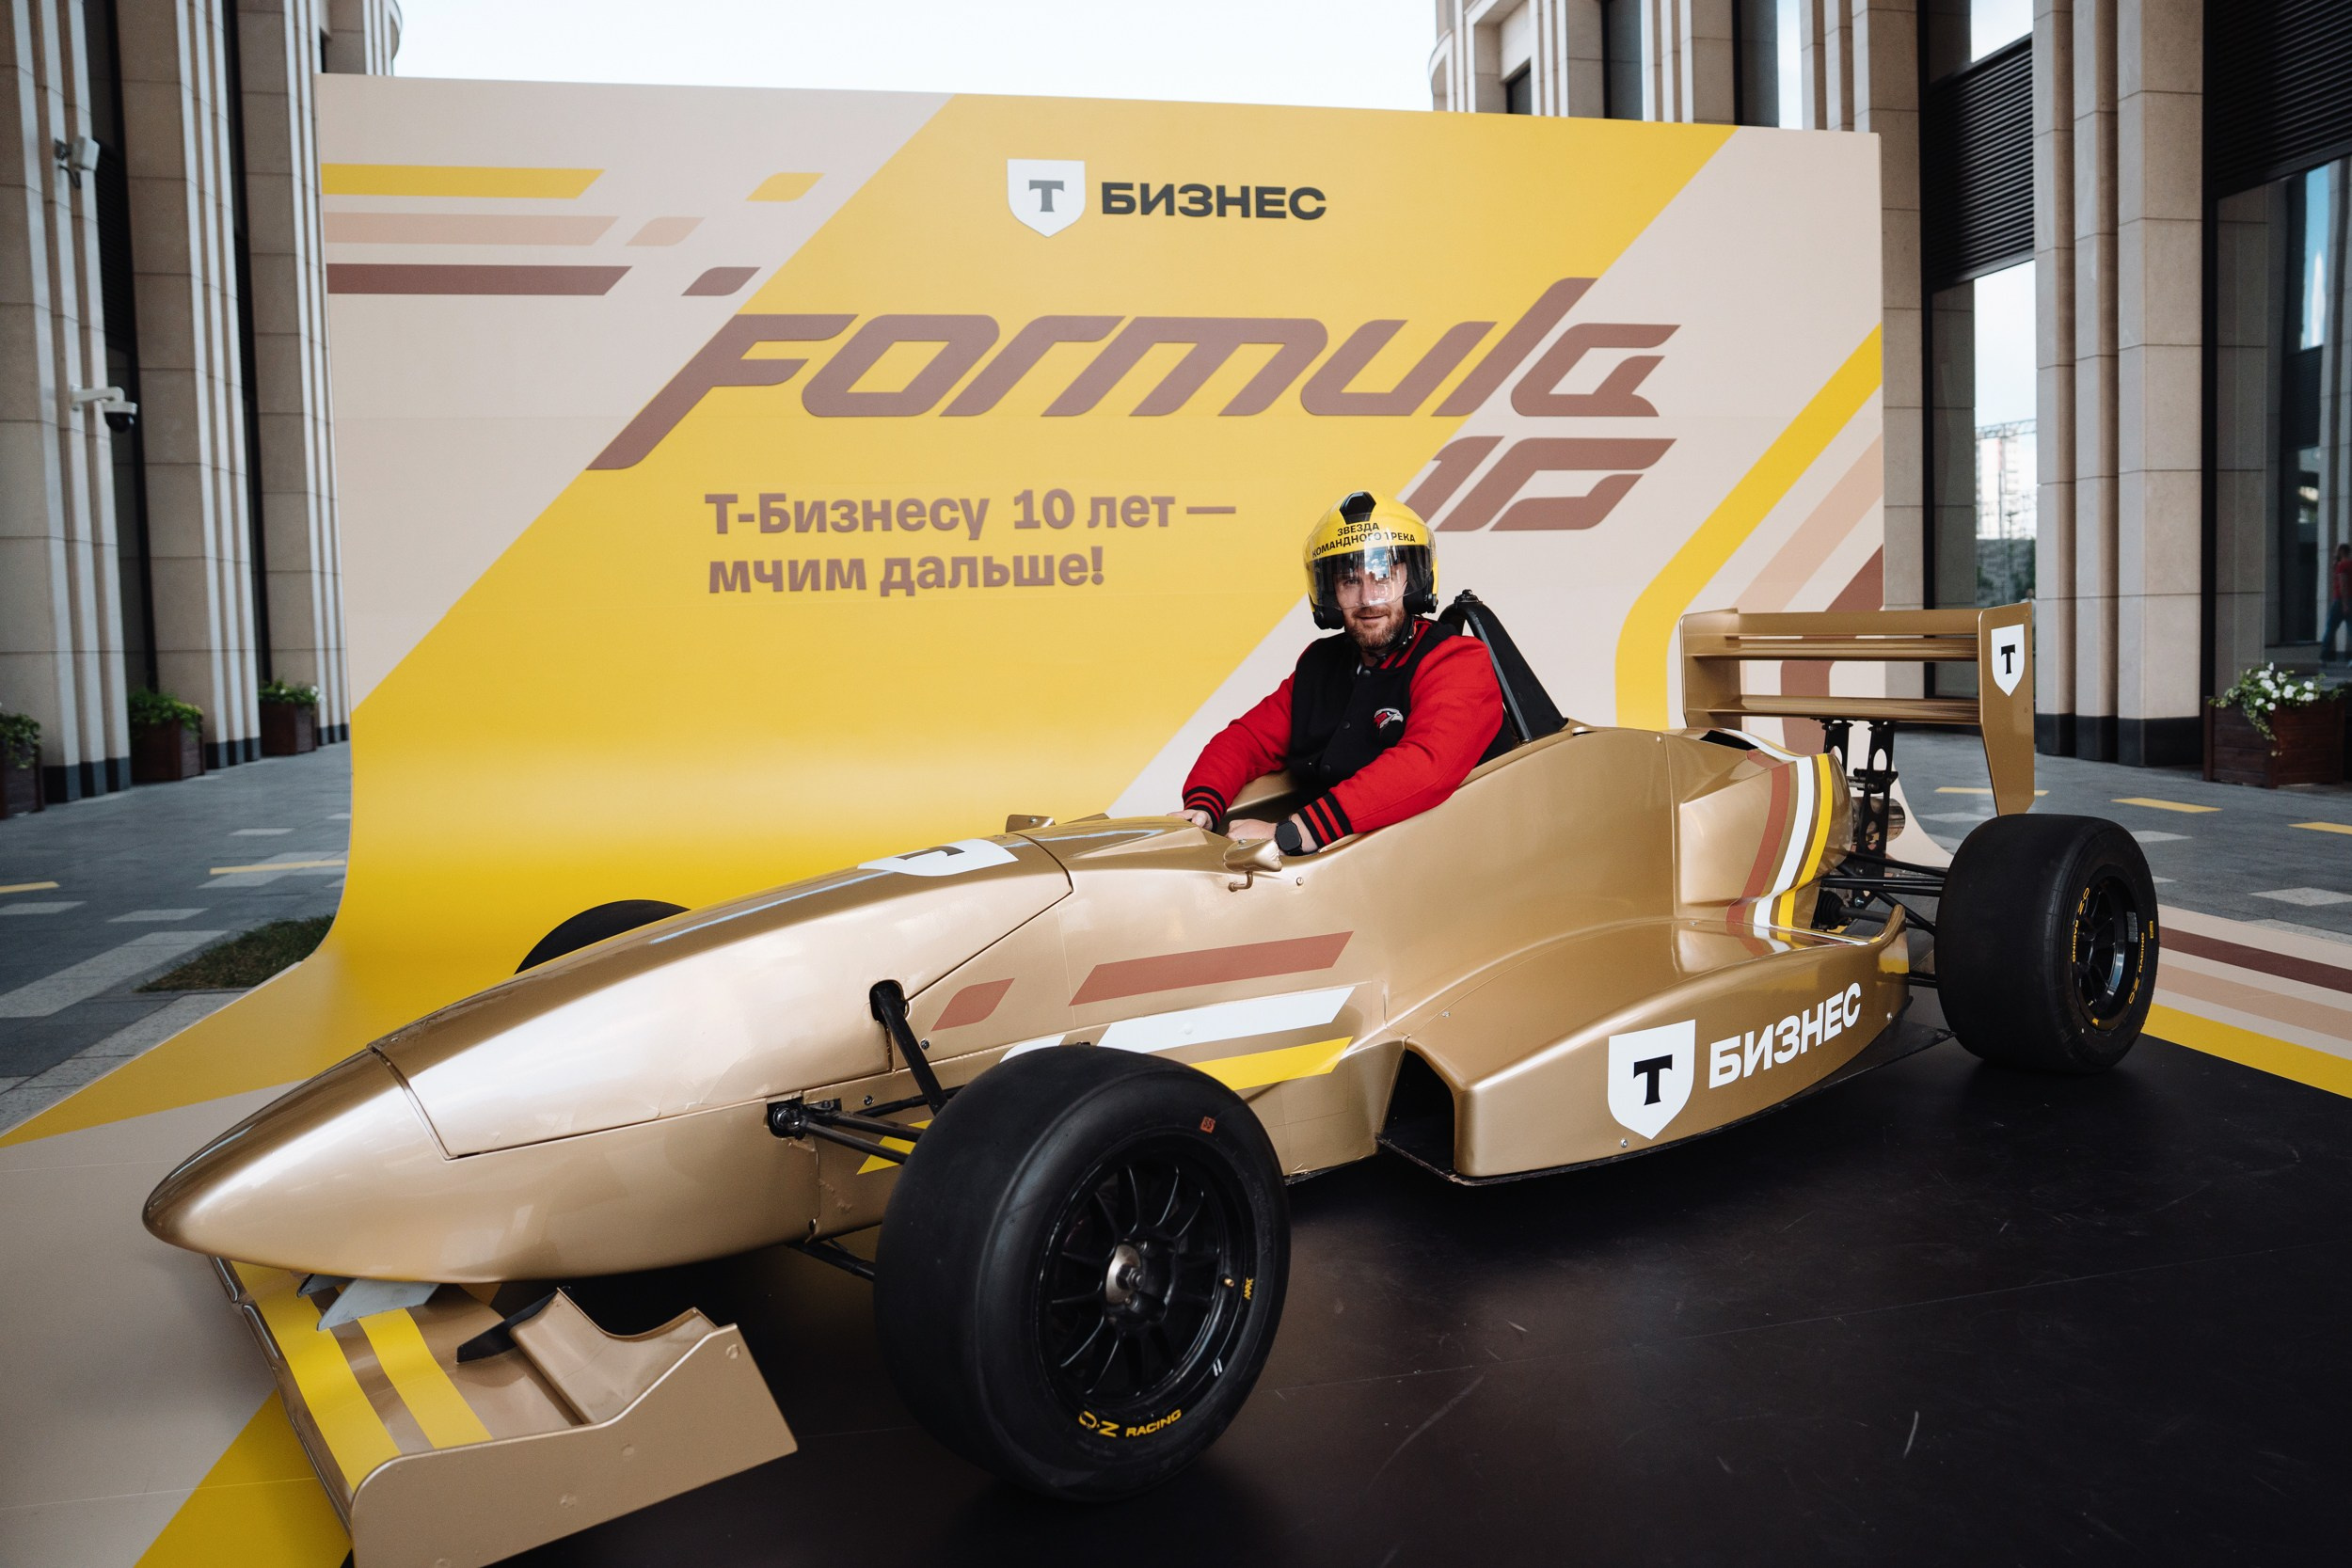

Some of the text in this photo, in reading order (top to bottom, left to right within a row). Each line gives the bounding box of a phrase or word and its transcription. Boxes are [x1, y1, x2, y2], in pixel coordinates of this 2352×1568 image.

[1101, 182, 1327, 221] БИЗНЕС
[704, 492, 991, 541] Т-Бизнесу
[1012, 488, 1075, 531] 10
[1088, 494, 1176, 530] лет
[1337, 522, 1380, 537] ЗВЕЗДА
[1311, 531, 1382, 559] КОМАНДНОГО
[708, 546, 1105, 597] мчим дальше!
[1708, 982, 1862, 1089] БИЗНЕС
[1125, 1409, 1183, 1437] RACING
